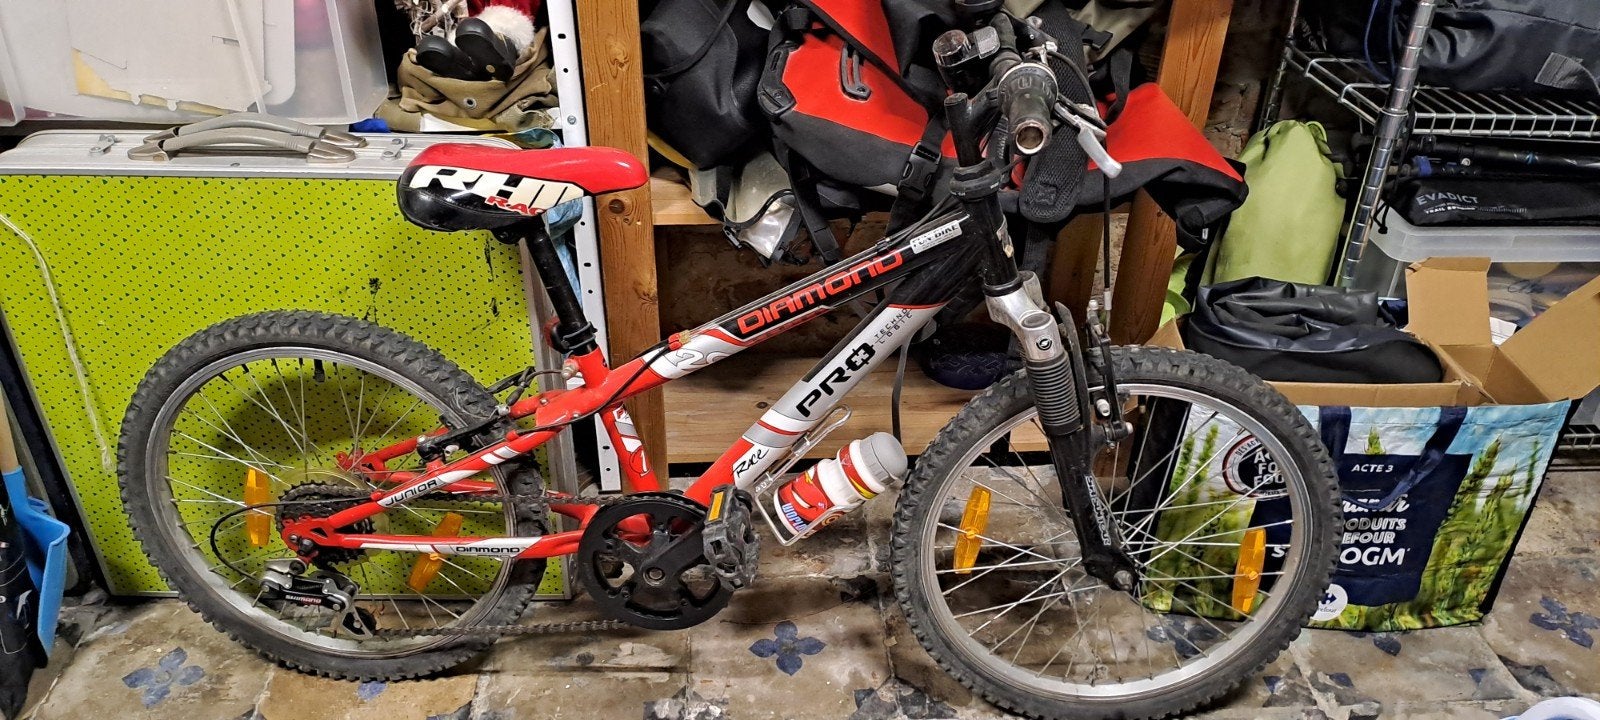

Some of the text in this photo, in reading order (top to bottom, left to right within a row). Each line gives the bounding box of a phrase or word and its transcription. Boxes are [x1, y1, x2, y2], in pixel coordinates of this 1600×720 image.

[1416, 192, 1478, 205] EVADICT
[736, 249, 904, 334] DIAMOND
[874, 308, 908, 339] TECHNO
[796, 342, 877, 418] PRO
[1258, 461, 1278, 475] FO
[1351, 464, 1394, 473] ACTE 3
[1253, 473, 1286, 488] FOO
[385, 478, 438, 506] JUNIOR
[1344, 517, 1407, 531] ODUITS
[1341, 531, 1396, 545] EFOUR
[456, 546, 520, 555] DIAMOND
